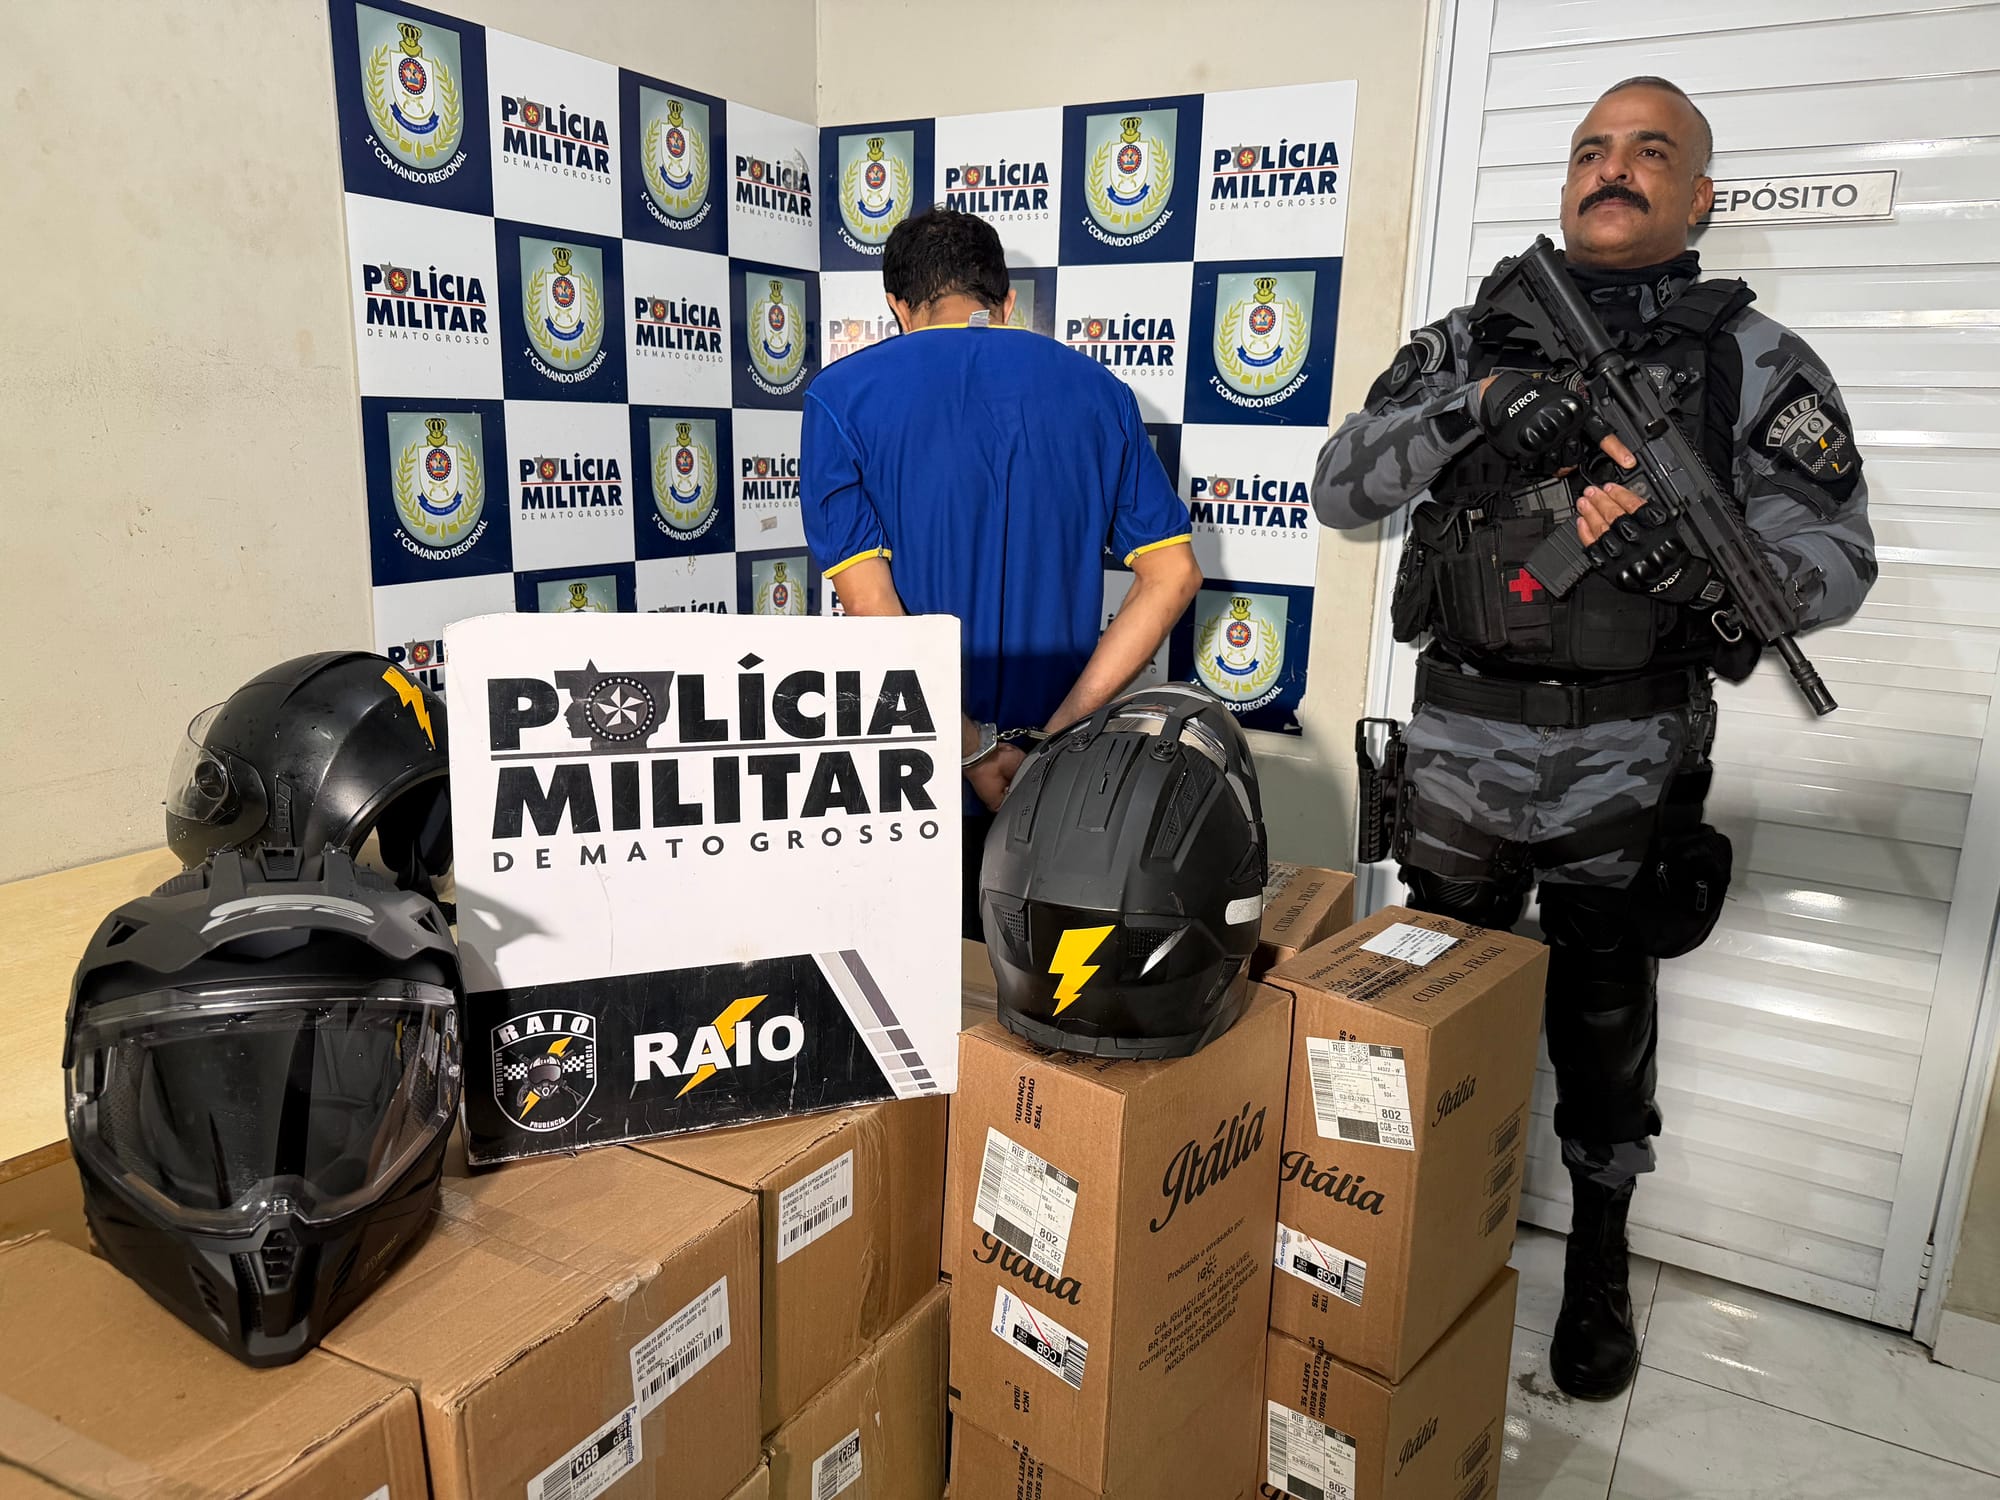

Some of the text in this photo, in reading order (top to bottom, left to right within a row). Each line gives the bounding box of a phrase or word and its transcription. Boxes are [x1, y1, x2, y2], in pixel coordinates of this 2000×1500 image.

[501, 95, 609, 145] POLÍCIA
[503, 127, 610, 174] MILITAR
[1213, 139, 1339, 172] POLÍCIA
[374, 147, 427, 183] COMANDO
[427, 150, 467, 184] REGIONAL
[564, 166, 611, 185] GROSSO
[736, 155, 811, 193] POLÍCIA
[946, 159, 1048, 189] POLÍCIA
[736, 181, 811, 218] MILITAR
[1211, 171, 1337, 200] MILITAR
[1712, 181, 1858, 213] EPÓSITO
[946, 188, 1048, 213] MILITAR
[1276, 197, 1337, 207] GROSSO
[646, 201, 683, 230] COMANDO
[683, 201, 712, 230] REGIONAL
[777, 213, 812, 227] GROSSO
[1000, 212, 1049, 221] GROSSO
[1088, 225, 1132, 246] COMANDO
[1132, 209, 1173, 245] REGIONAL
[844, 235, 880, 255] COMANDO
[363, 264, 486, 304] POLÍCIA
[366, 297, 488, 333] MILITAR
[635, 297, 721, 329] POLÍCIA
[1066, 313, 1175, 340] POLÍCIA
[435, 334, 490, 345] GROSSO
[636, 324, 722, 353] MILITAR
[531, 358, 574, 383] COMANDO
[574, 350, 607, 383] REGIONAL
[684, 353, 723, 363] GROSSO
[1122, 368, 1175, 377] GROSSO
[1216, 384, 1263, 408] COMANDO
[1264, 373, 1308, 407] REGIONAL
[1507, 389, 1540, 418] ATROX
[1770, 399, 1811, 439] RAIO
[519, 453, 622, 482] POLÍCIA
[741, 453, 800, 478] POLÍCI
[521, 485, 623, 510] MILITAR
[743, 481, 801, 500] MILITA
[1191, 474, 1309, 503] POLÍCIA
[578, 509, 624, 518] GROSSO
[783, 500, 800, 508] GRO
[1191, 502, 1308, 529] MILITAR
[658, 522, 692, 541] COMANDO
[692, 508, 719, 539] REGIONAL
[1251, 528, 1308, 540] GROSSO
[402, 538, 450, 560] COMANDO
[450, 520, 488, 559] REGIONAL
[487, 652, 936, 751] POLÍCIA
[1242, 685, 1283, 711] REGIONAL
[492, 748, 937, 839] MILITAR
[493, 820, 940, 872] DE MATO GROSSO
[1464, 945, 1506, 975] FRÁGIL
[498, 1014, 590, 1044] RAIO
[633, 1014, 805, 1081] RAIO
[1034, 1104, 1043, 1130] SEAL
[1381, 1108, 1401, 1120] 802
[1149, 1101, 1267, 1234] Itália
[1280, 1150, 1385, 1215] Itália
[1039, 1226, 1058, 1247] 802
[1316, 1266, 1336, 1285] CGB
[1036, 1339, 1057, 1363] CGB
[574, 1442, 599, 1476] CGB
[1329, 1479, 1346, 1496] 802
